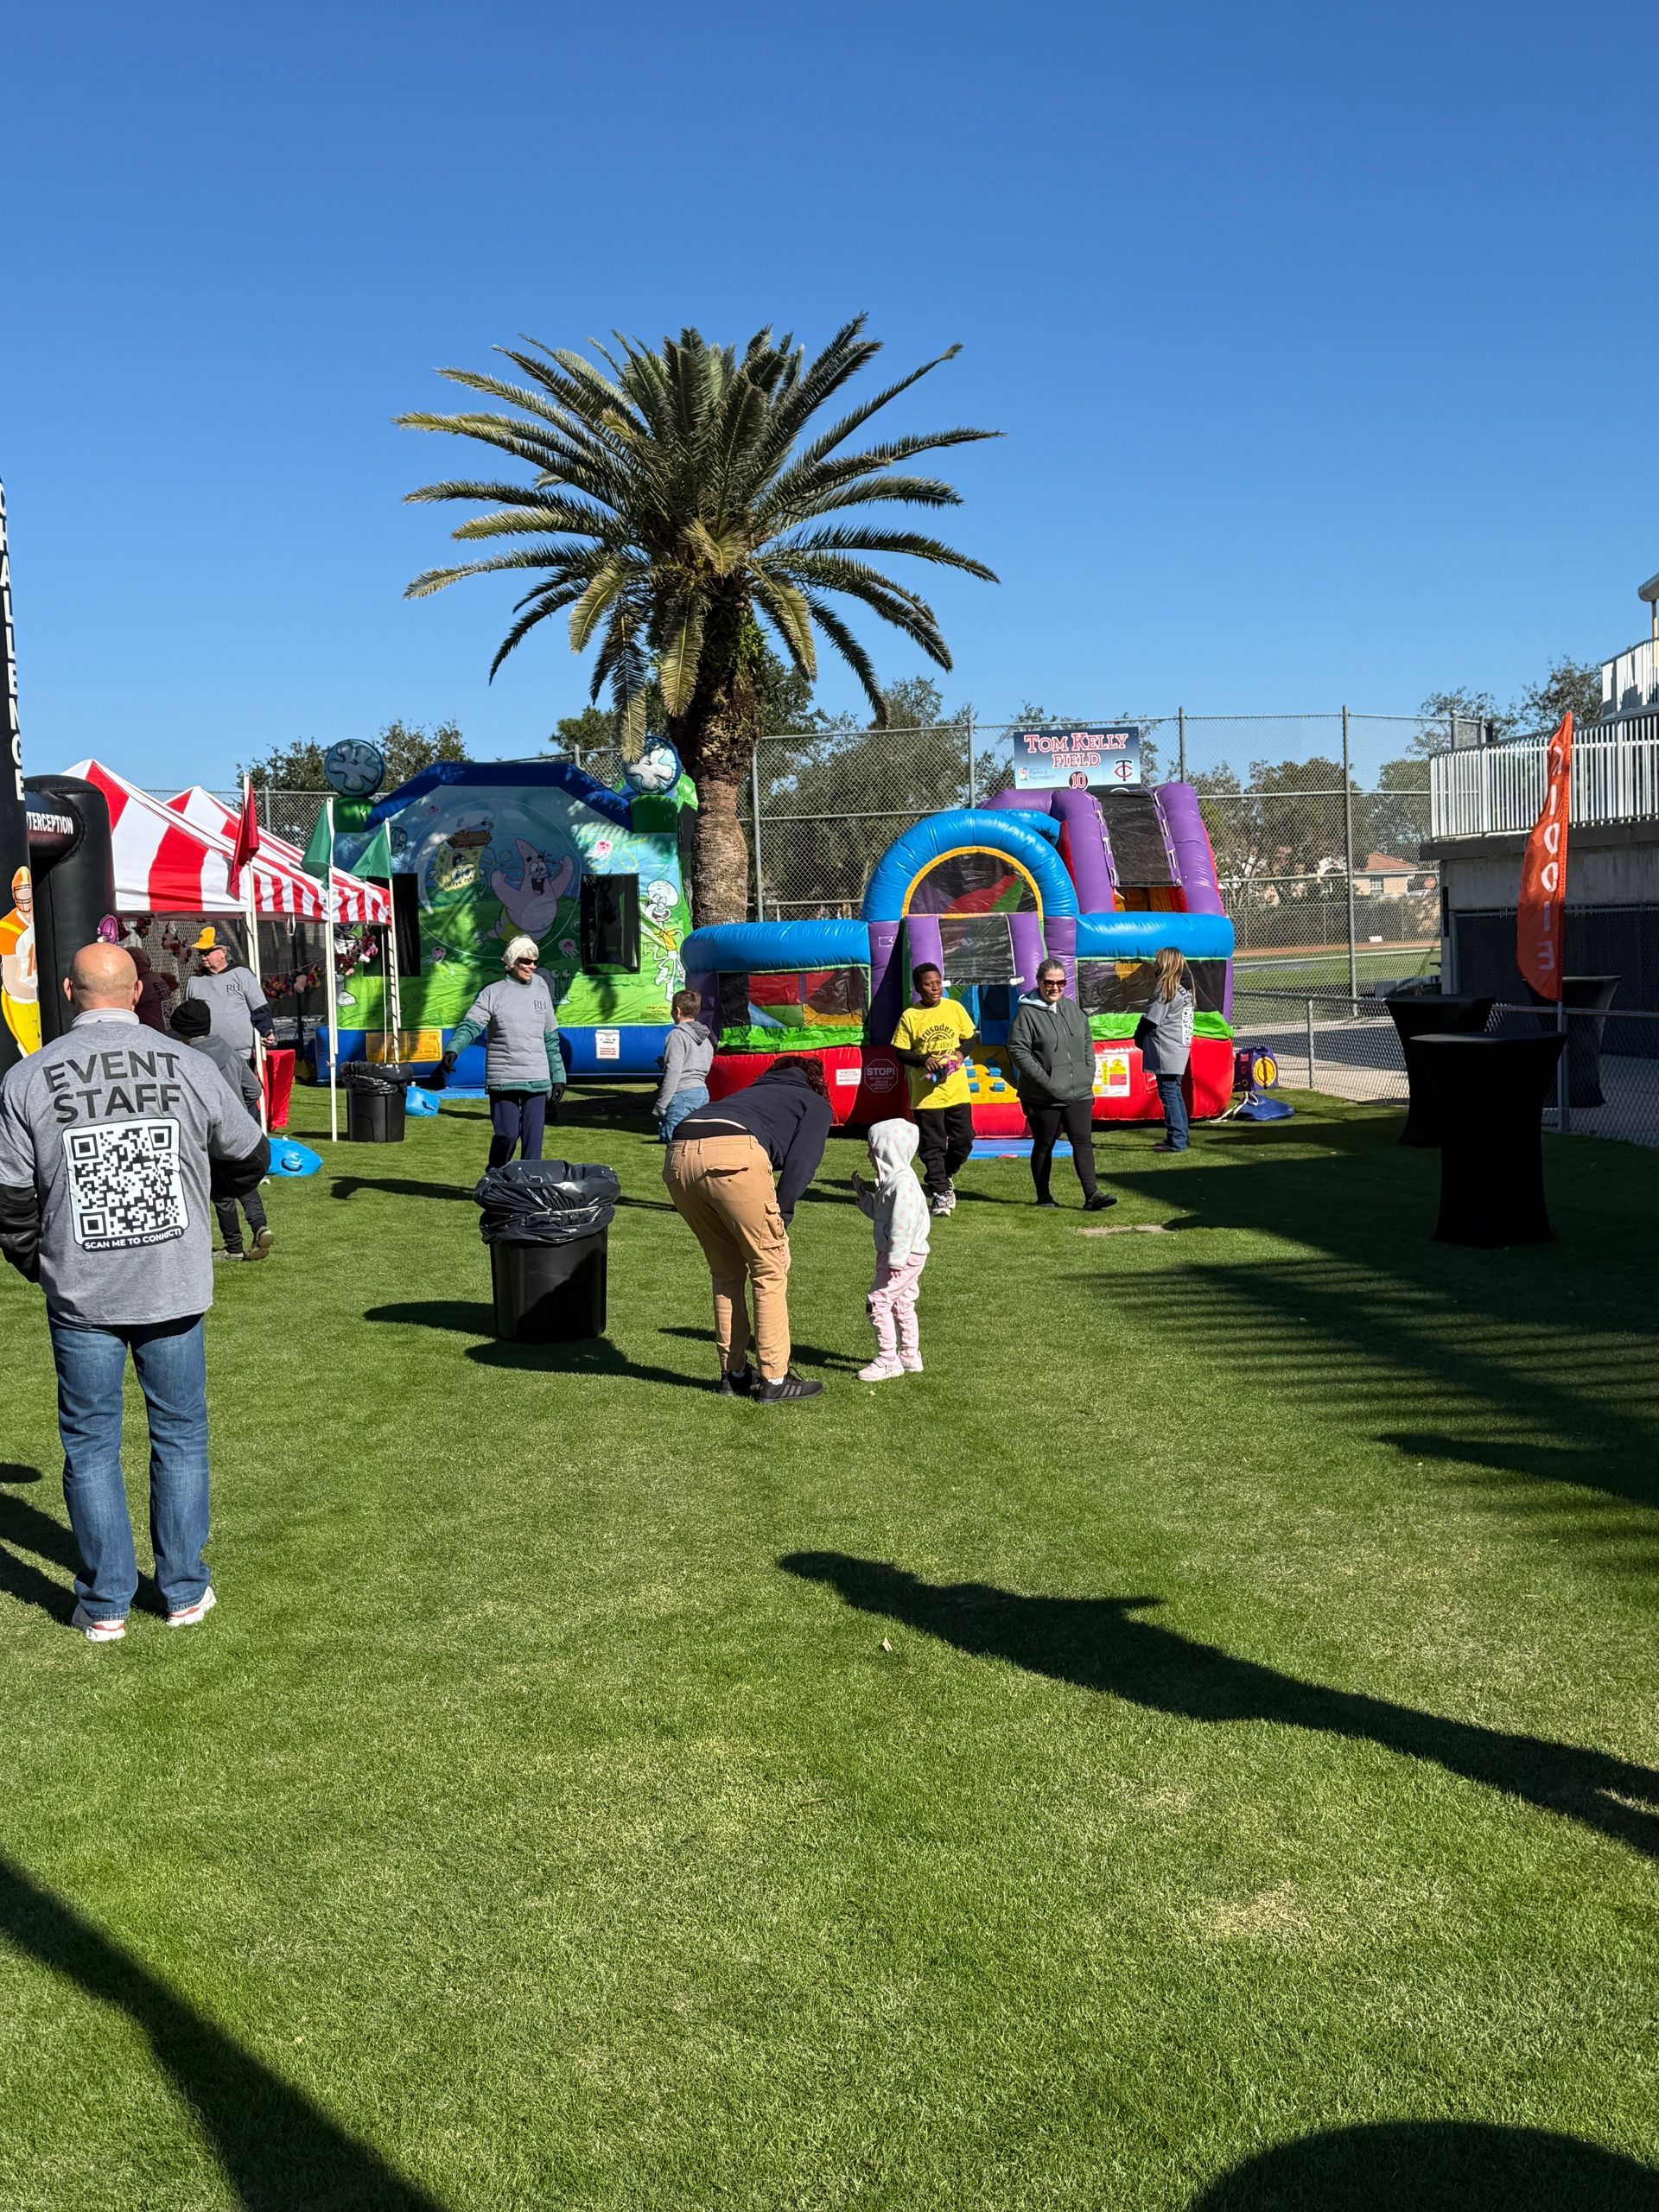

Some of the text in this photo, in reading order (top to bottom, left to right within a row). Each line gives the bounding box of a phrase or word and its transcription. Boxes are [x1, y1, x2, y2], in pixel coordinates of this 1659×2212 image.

[1024, 733, 1128, 753] TOM KELLY
[1052, 752, 1101, 769] FIELD
[1071, 772, 1087, 789] 10
[26, 810, 74, 835] TERCEPTION
[42, 1050, 181, 1094] EVENT
[867, 1067, 895, 1076] STOP!
[54, 1084, 181, 1123] STAFF
[85, 1241, 111, 1249] SCAN
[111, 1238, 126, 1248] ME
[127, 1236, 141, 1245] TO
